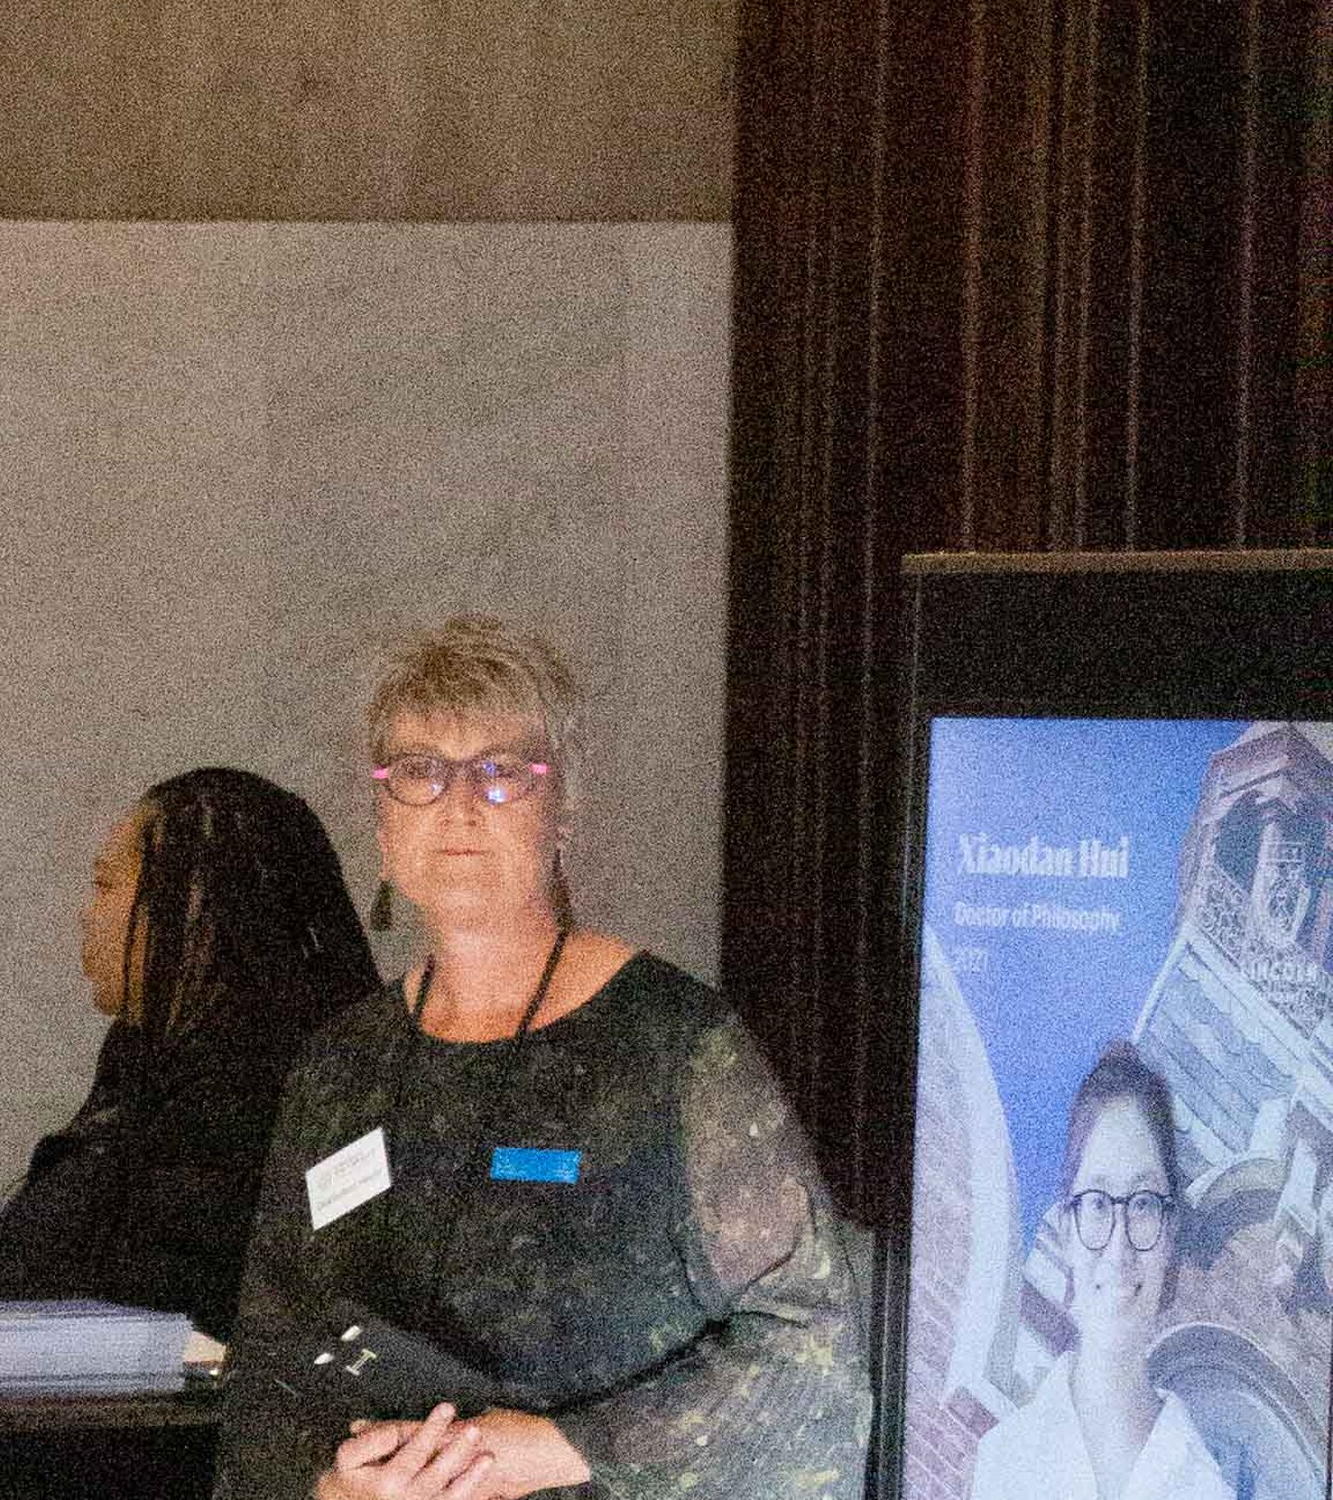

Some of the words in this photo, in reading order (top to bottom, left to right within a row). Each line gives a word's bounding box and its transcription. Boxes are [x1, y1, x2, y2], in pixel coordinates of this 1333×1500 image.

[958, 831, 1071, 877] Xiaodan
[1079, 835, 1129, 879] Hui
[953, 901, 1009, 927] Doctor
[1012, 903, 1029, 928] of
[1031, 904, 1121, 935] Philosophy
